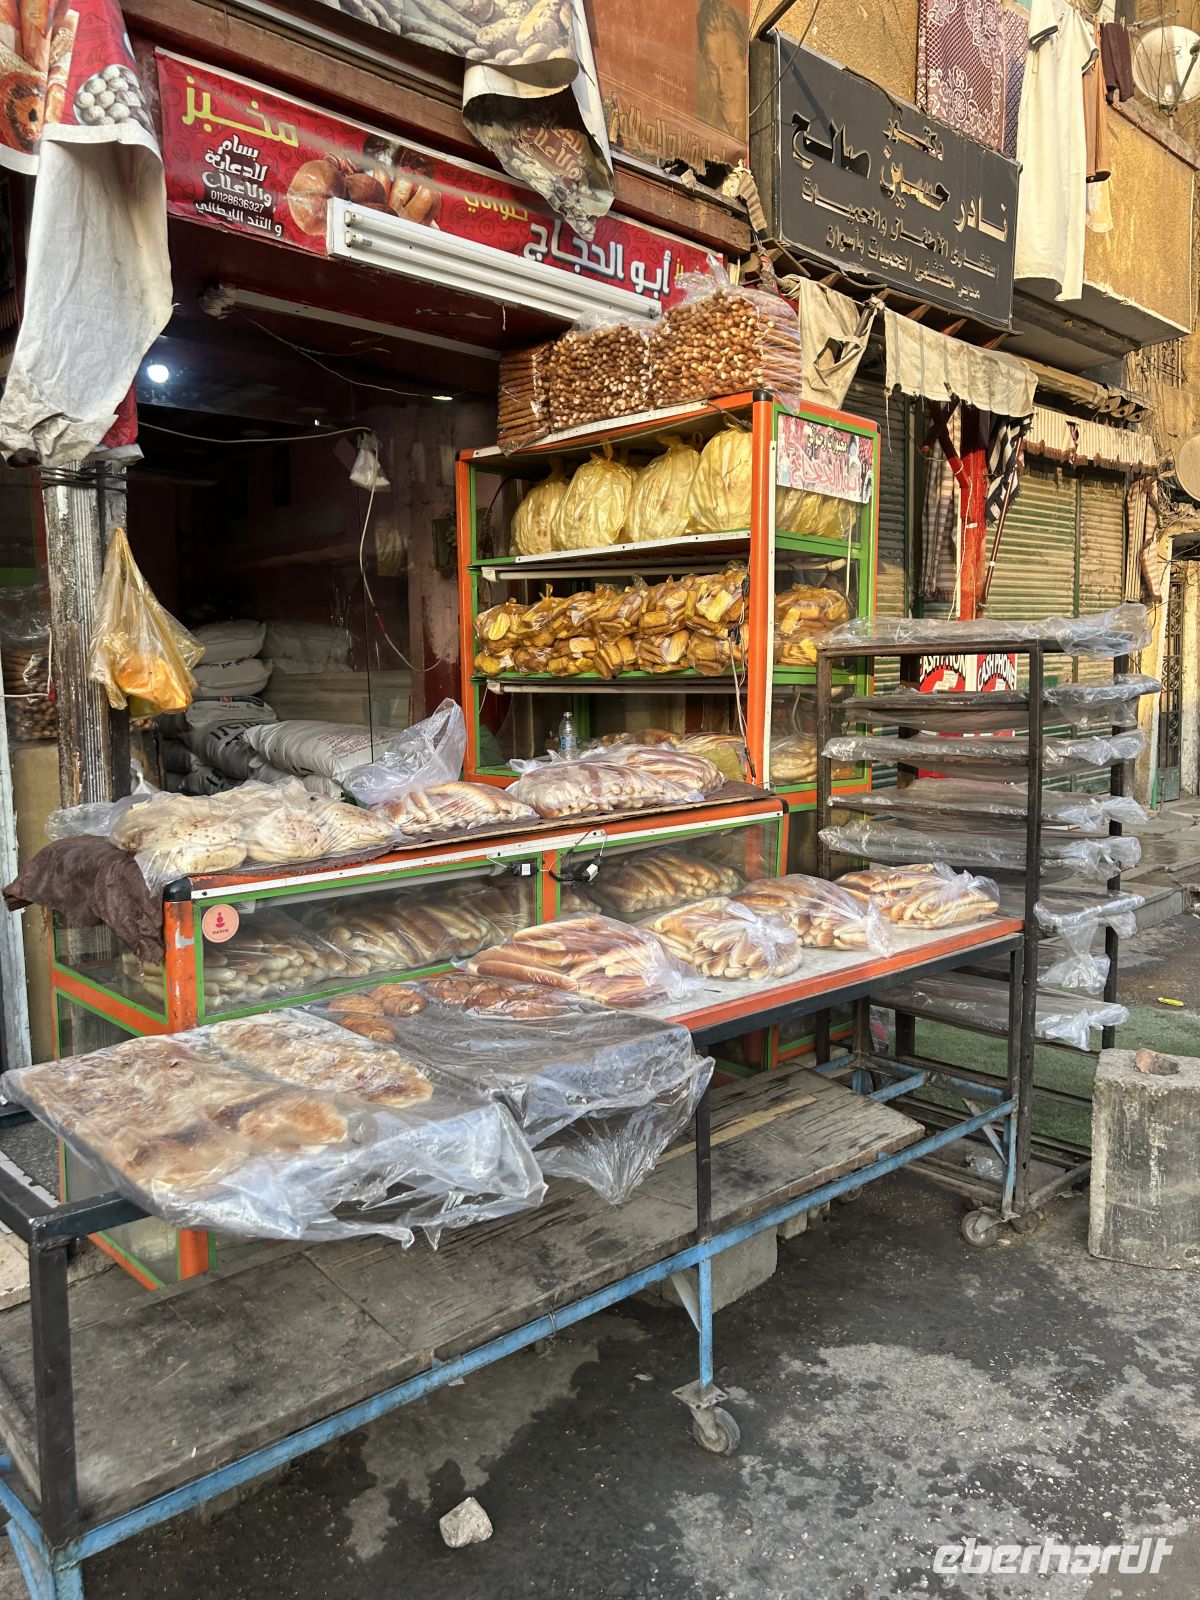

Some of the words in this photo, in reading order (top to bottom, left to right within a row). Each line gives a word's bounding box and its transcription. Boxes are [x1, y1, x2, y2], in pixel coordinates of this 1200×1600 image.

[182, 75, 299, 148] مخبز
[204, 149, 268, 181] للدعاية
[217, 134, 259, 161] بسام
[791, 111, 872, 179] صالح
[210, 190, 265, 213] 01128636327
[880, 144, 950, 211] حسين
[274, 224, 282, 237] و
[953, 195, 1007, 243] نادر
[523, 219, 624, 279] الحجاج
[630, 249, 671, 299] أبو
